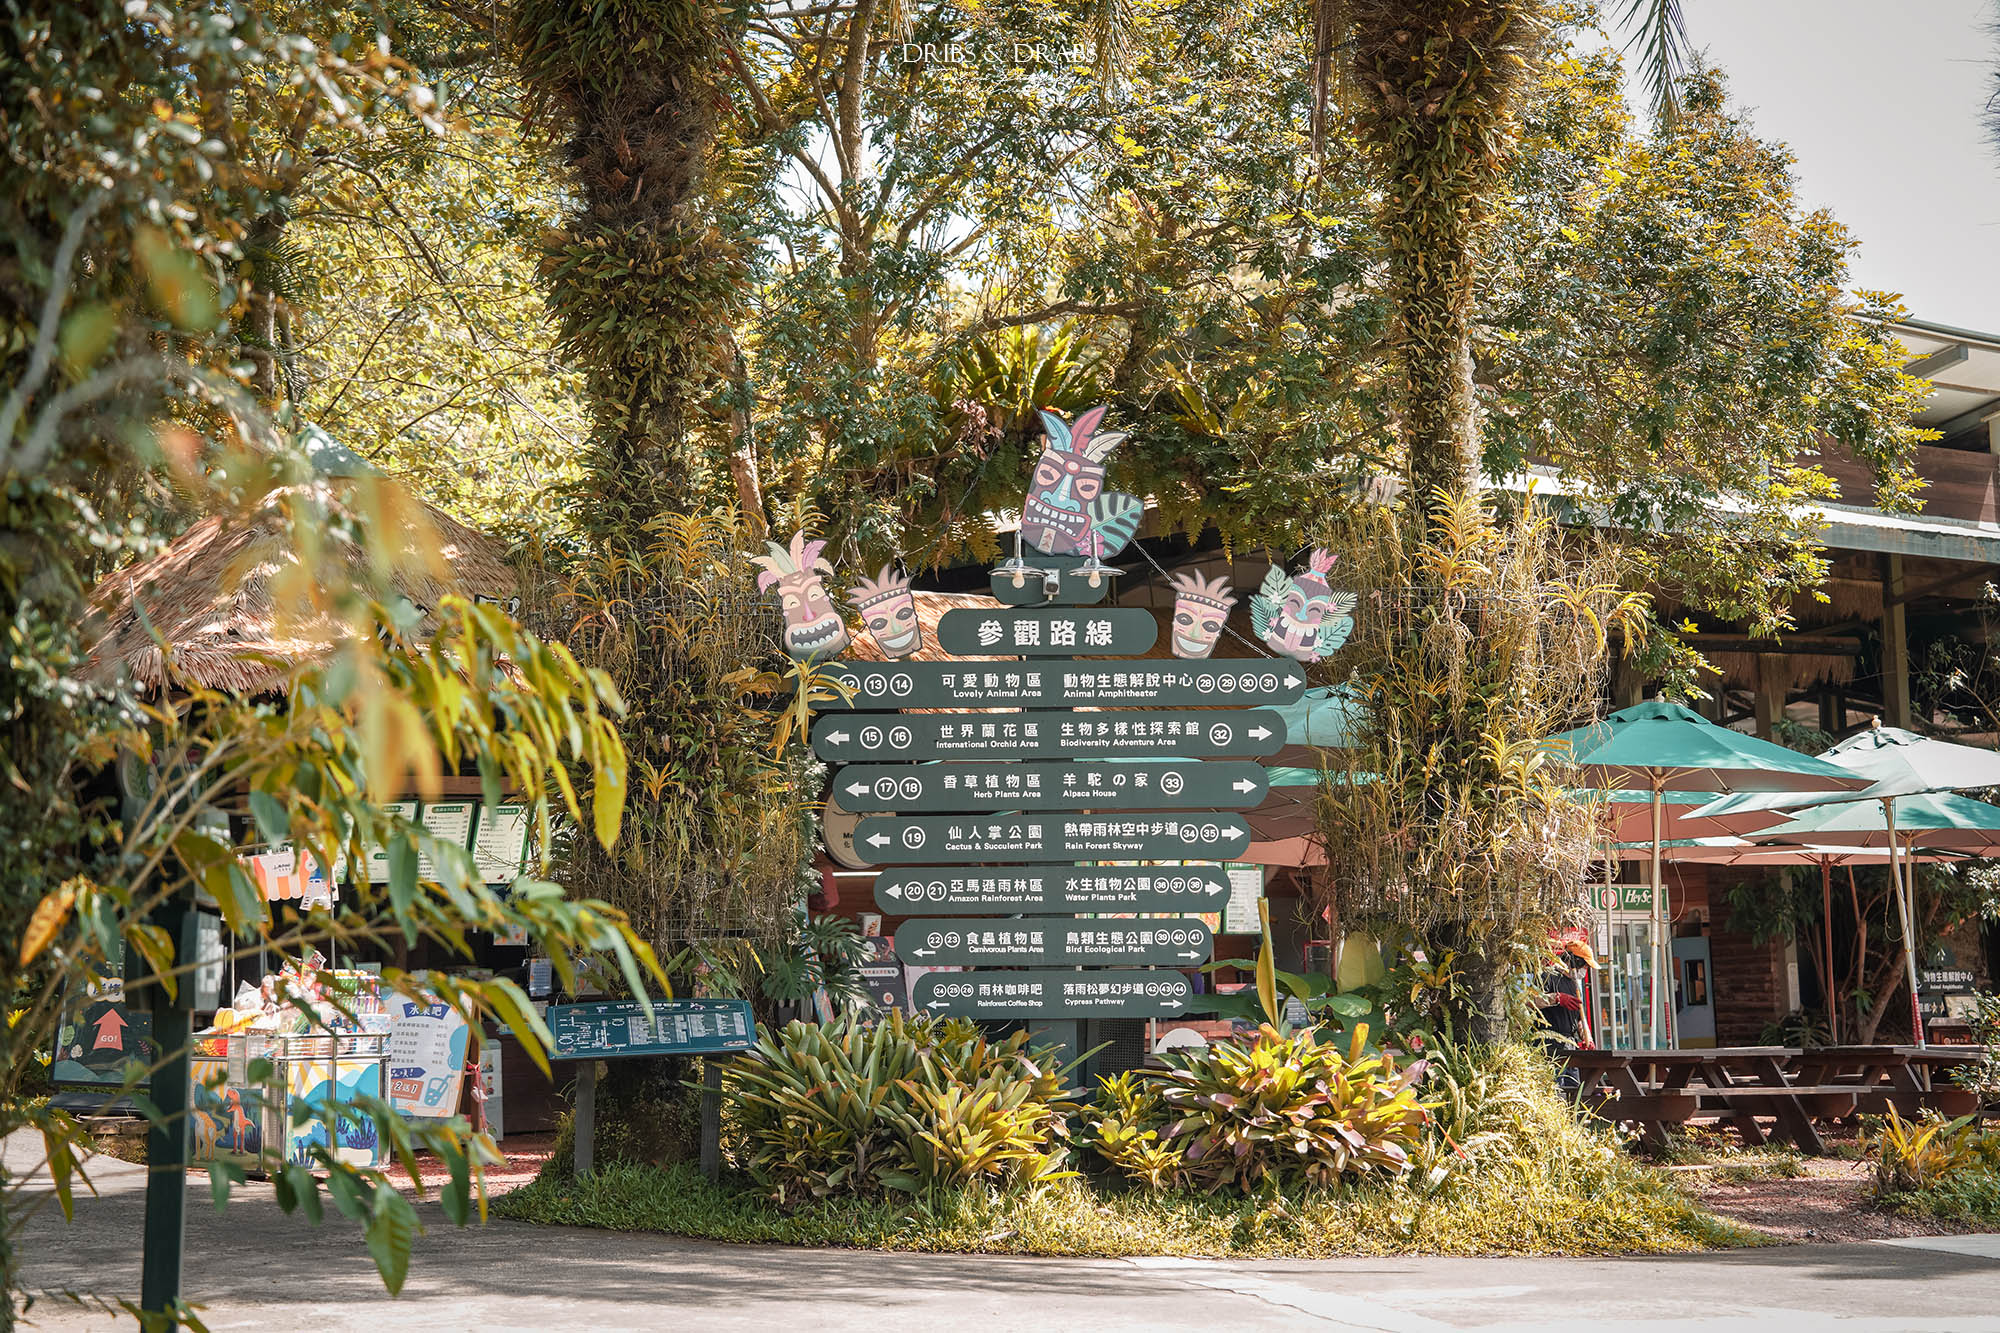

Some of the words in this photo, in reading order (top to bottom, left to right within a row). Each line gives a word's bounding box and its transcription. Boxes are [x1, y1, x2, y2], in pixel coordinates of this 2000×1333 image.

[978, 620, 1112, 646] 參觀路線
[942, 673, 1042, 688] 可愛動物區
[1064, 673, 1193, 688] 動物生態解說中心
[954, 690, 983, 698] Lovely
[987, 689, 1017, 697] Animal
[1098, 689, 1157, 698] Amphitheater
[941, 723, 1038, 738] 世界蘭花區
[1061, 721, 1199, 736] 生物多樣性探索館
[1061, 739, 1110, 747] Biodiversity
[944, 774, 1040, 788] 香草植物區
[1063, 773, 1148, 787] 羊駝の家
[1063, 790, 1090, 798] Alpaca
[948, 825, 1041, 840] 仙人掌公園
[1065, 822, 1178, 837] 熱帶雨林空中步道
[1113, 842, 1143, 850] Skyway
[951, 879, 1042, 892] 亞馬遜雨林區
[1066, 877, 1150, 891] 水生植物公園
[1118, 892, 1136, 901] Park
[967, 932, 1043, 945] 食蟲植物區
[1067, 932, 1153, 945] 鳥類生態公園
[1085, 946, 1125, 954] Ecological
[979, 984, 1042, 996] 雨林咖啡吧
[101, 1035, 117, 1043] GO!
